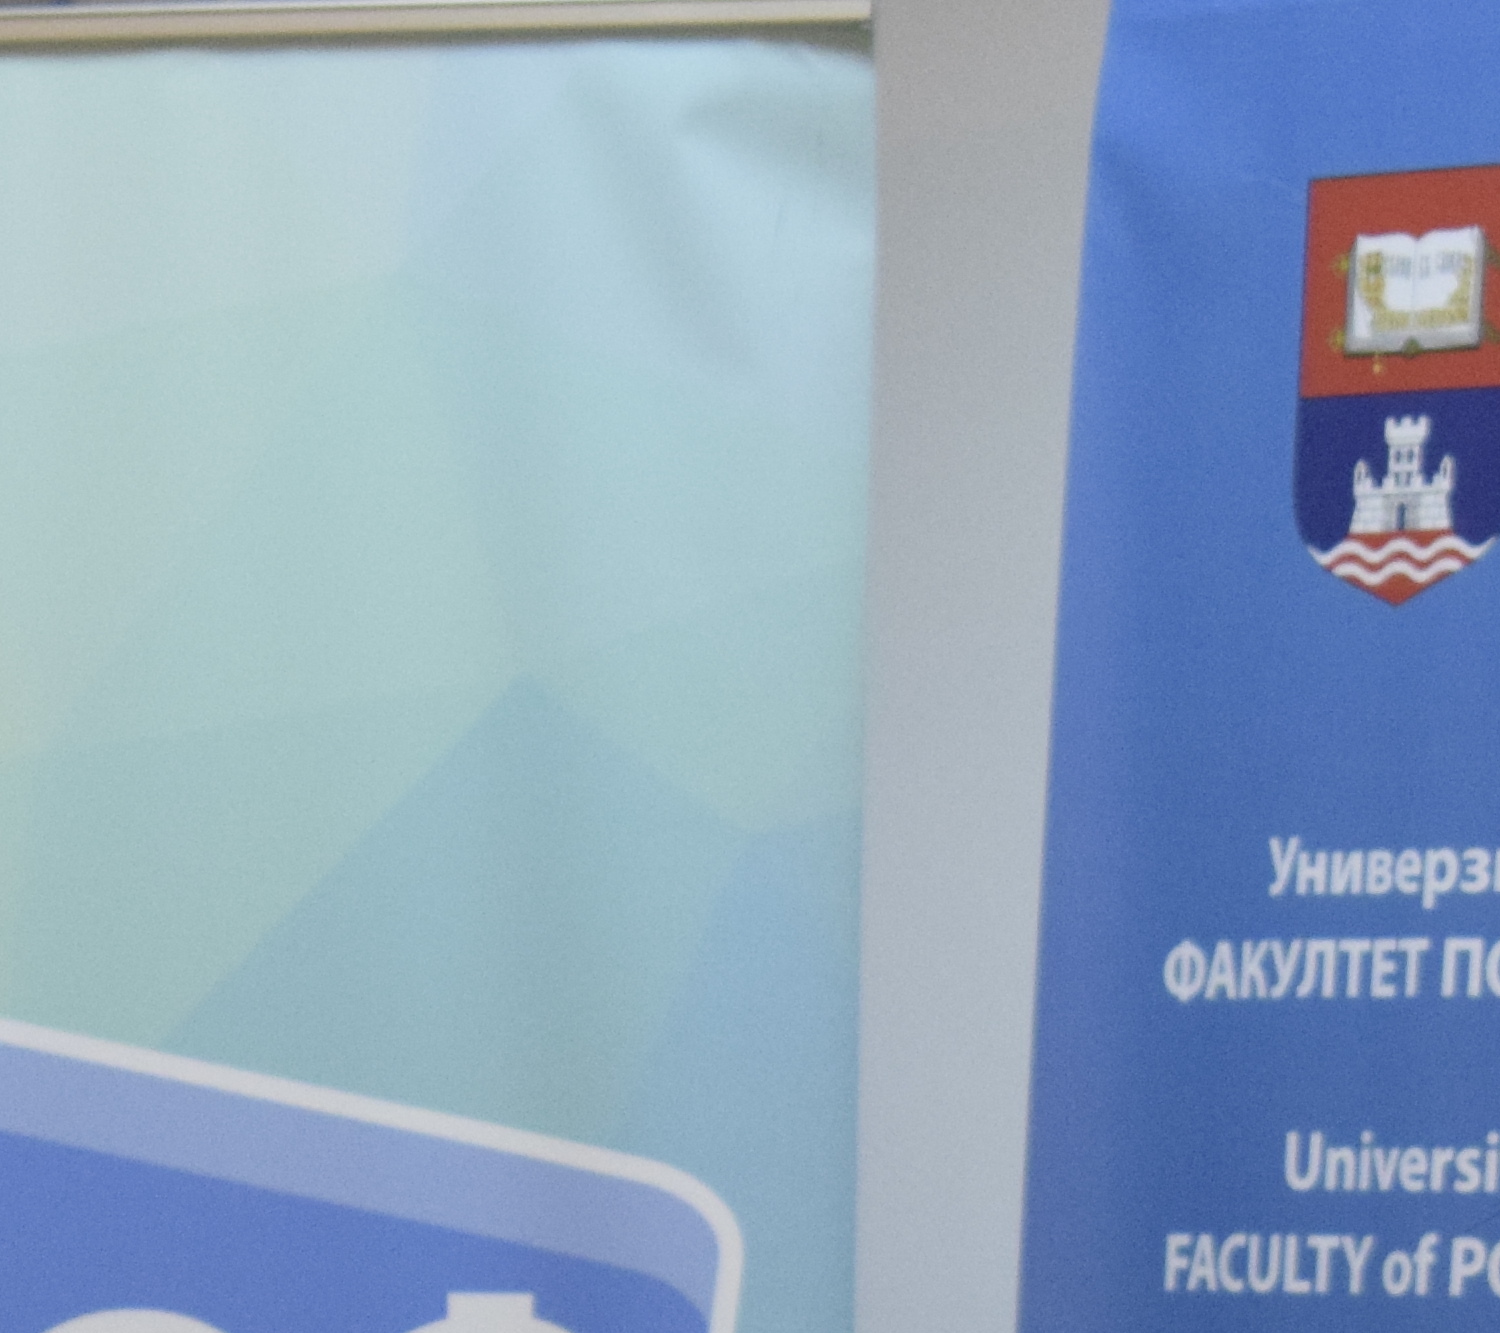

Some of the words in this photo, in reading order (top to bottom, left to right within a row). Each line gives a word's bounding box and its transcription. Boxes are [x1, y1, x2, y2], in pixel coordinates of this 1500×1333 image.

[1163, 938, 1430, 1003] ФАКУЛТЕТ
[1164, 1233, 1376, 1296] FACULTY
[1382, 1231, 1440, 1297] of
